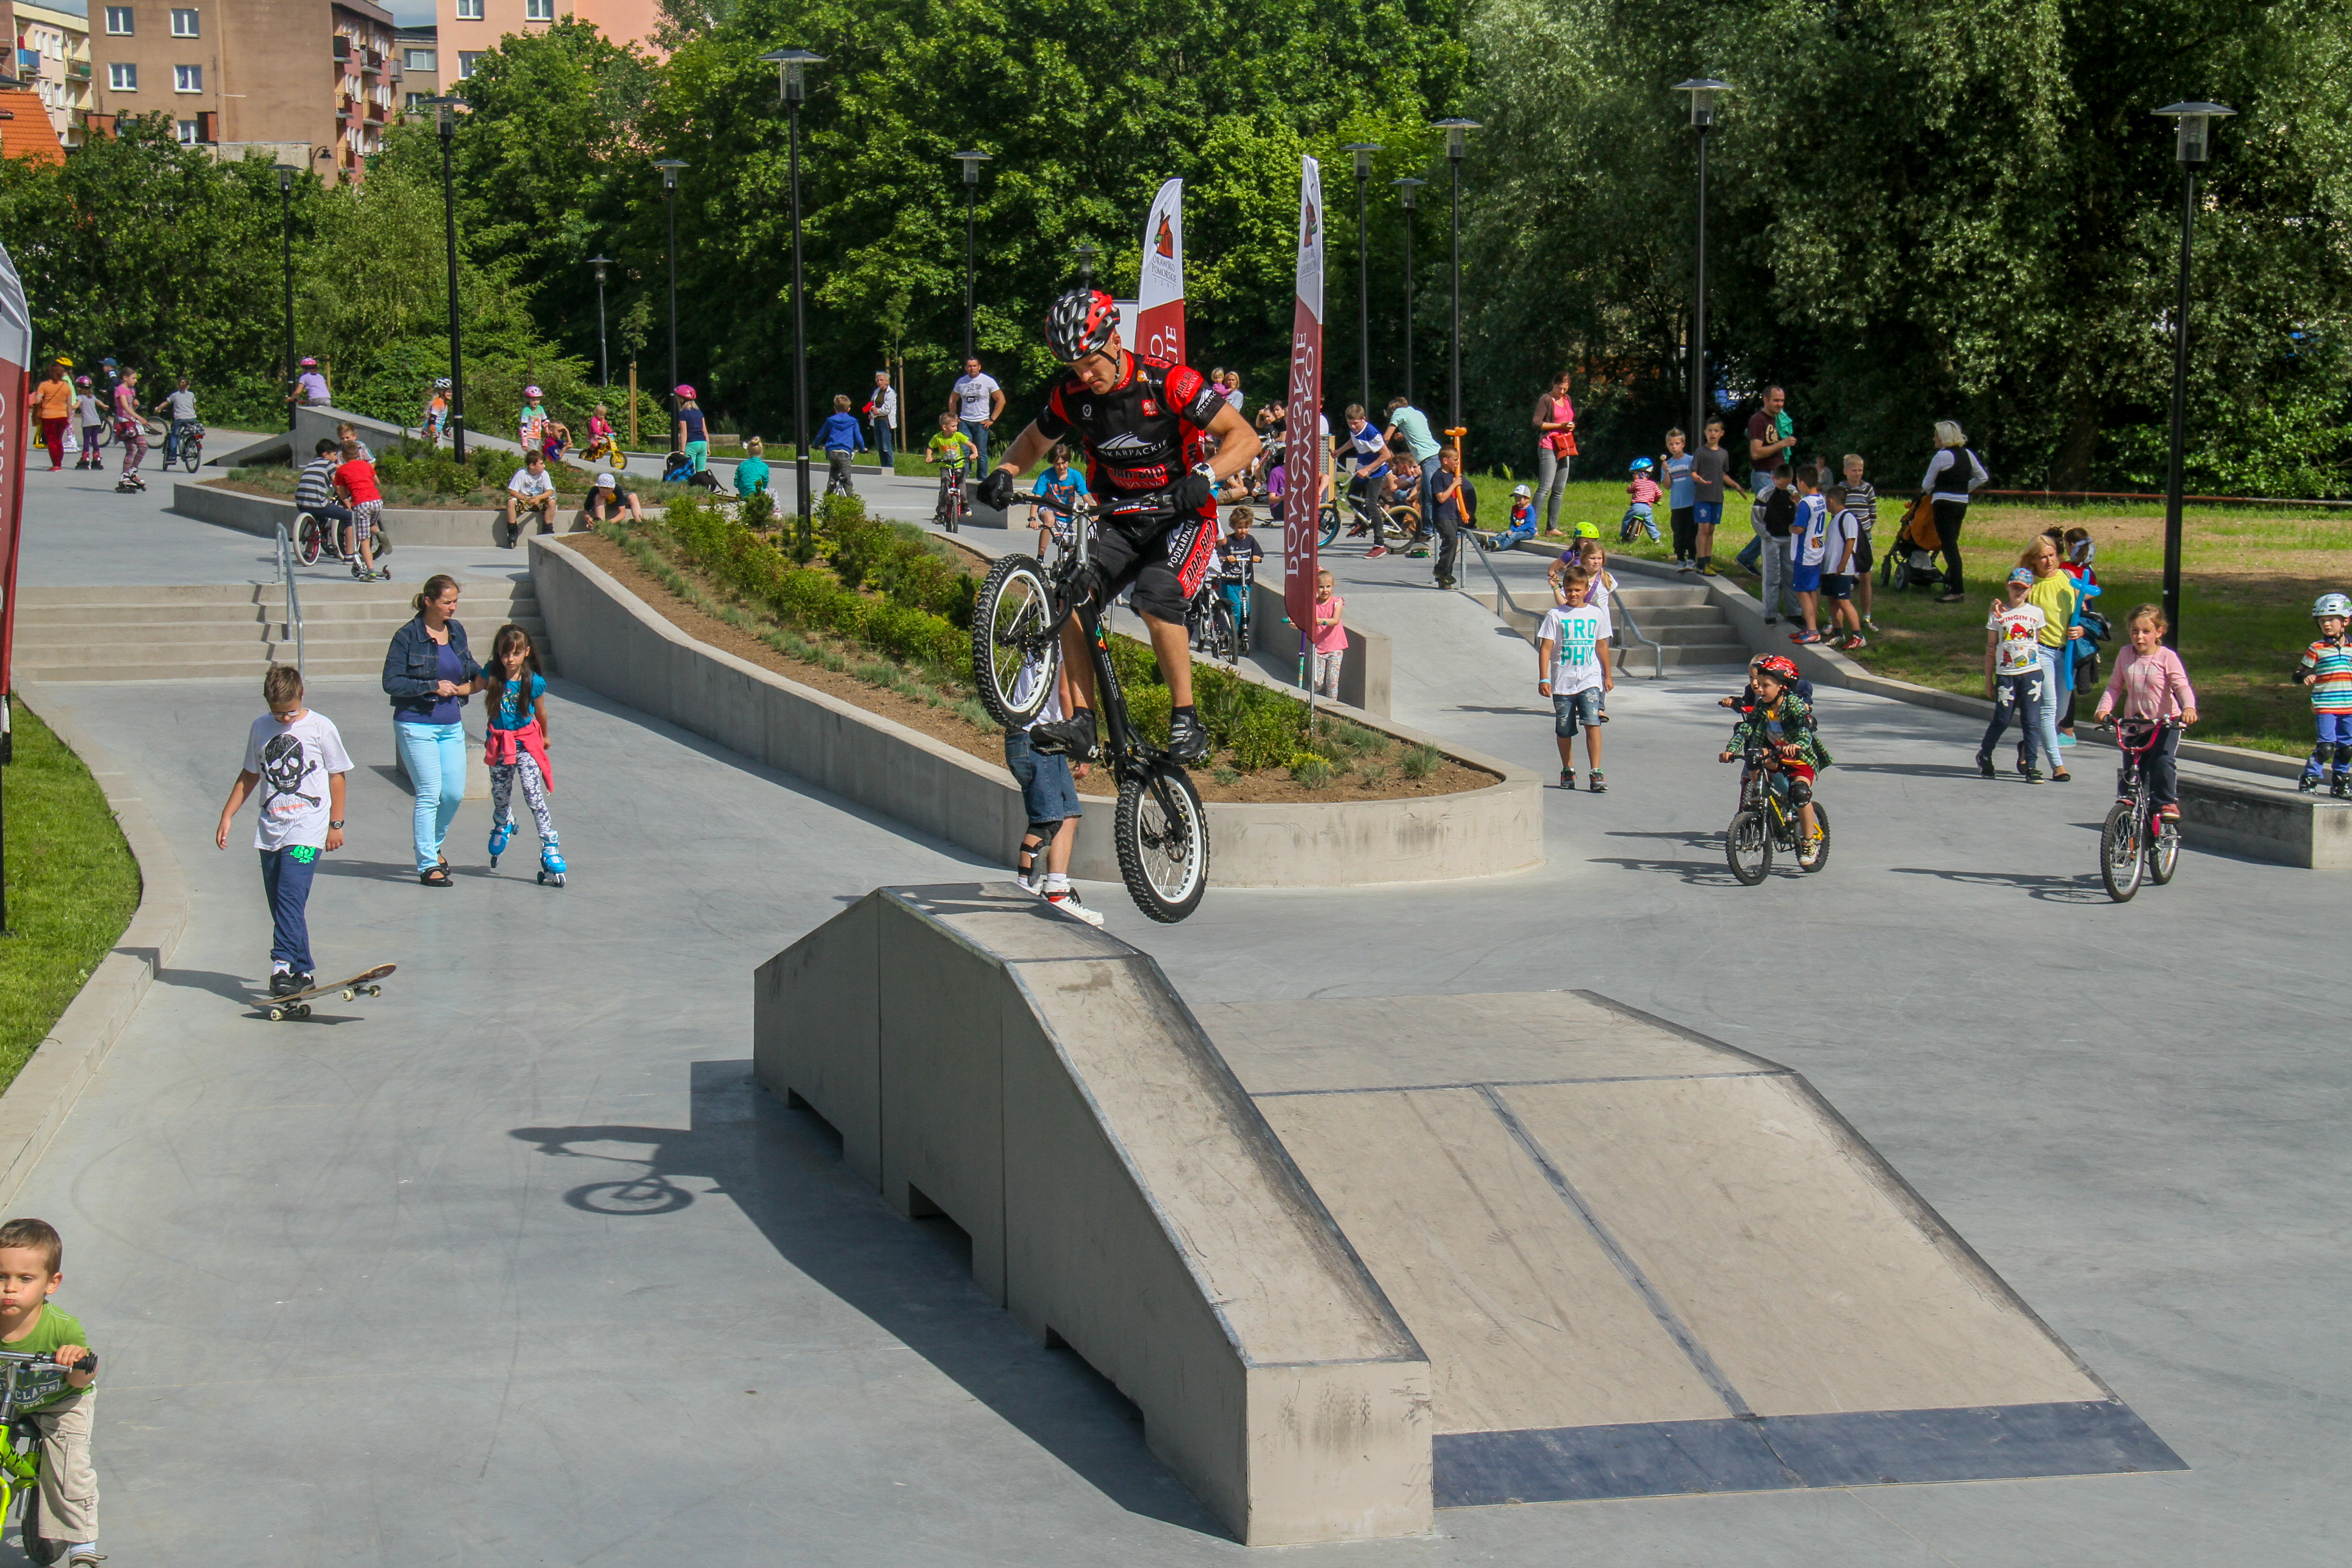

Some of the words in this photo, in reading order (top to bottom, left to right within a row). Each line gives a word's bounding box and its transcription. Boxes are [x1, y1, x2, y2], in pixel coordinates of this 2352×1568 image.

[1152, 263, 1177, 284] POMORSKIE
[1153, 255, 1175, 272] DRAWSKO
[1814, 511, 1825, 534] 10
[1561, 619, 1597, 639] TRO
[1998, 614, 2027, 625] WINGIN
[1561, 646, 1594, 666] PHY
[272, 797, 305, 817] SCHOOL
[15, 1384, 56, 1400] CLASS
